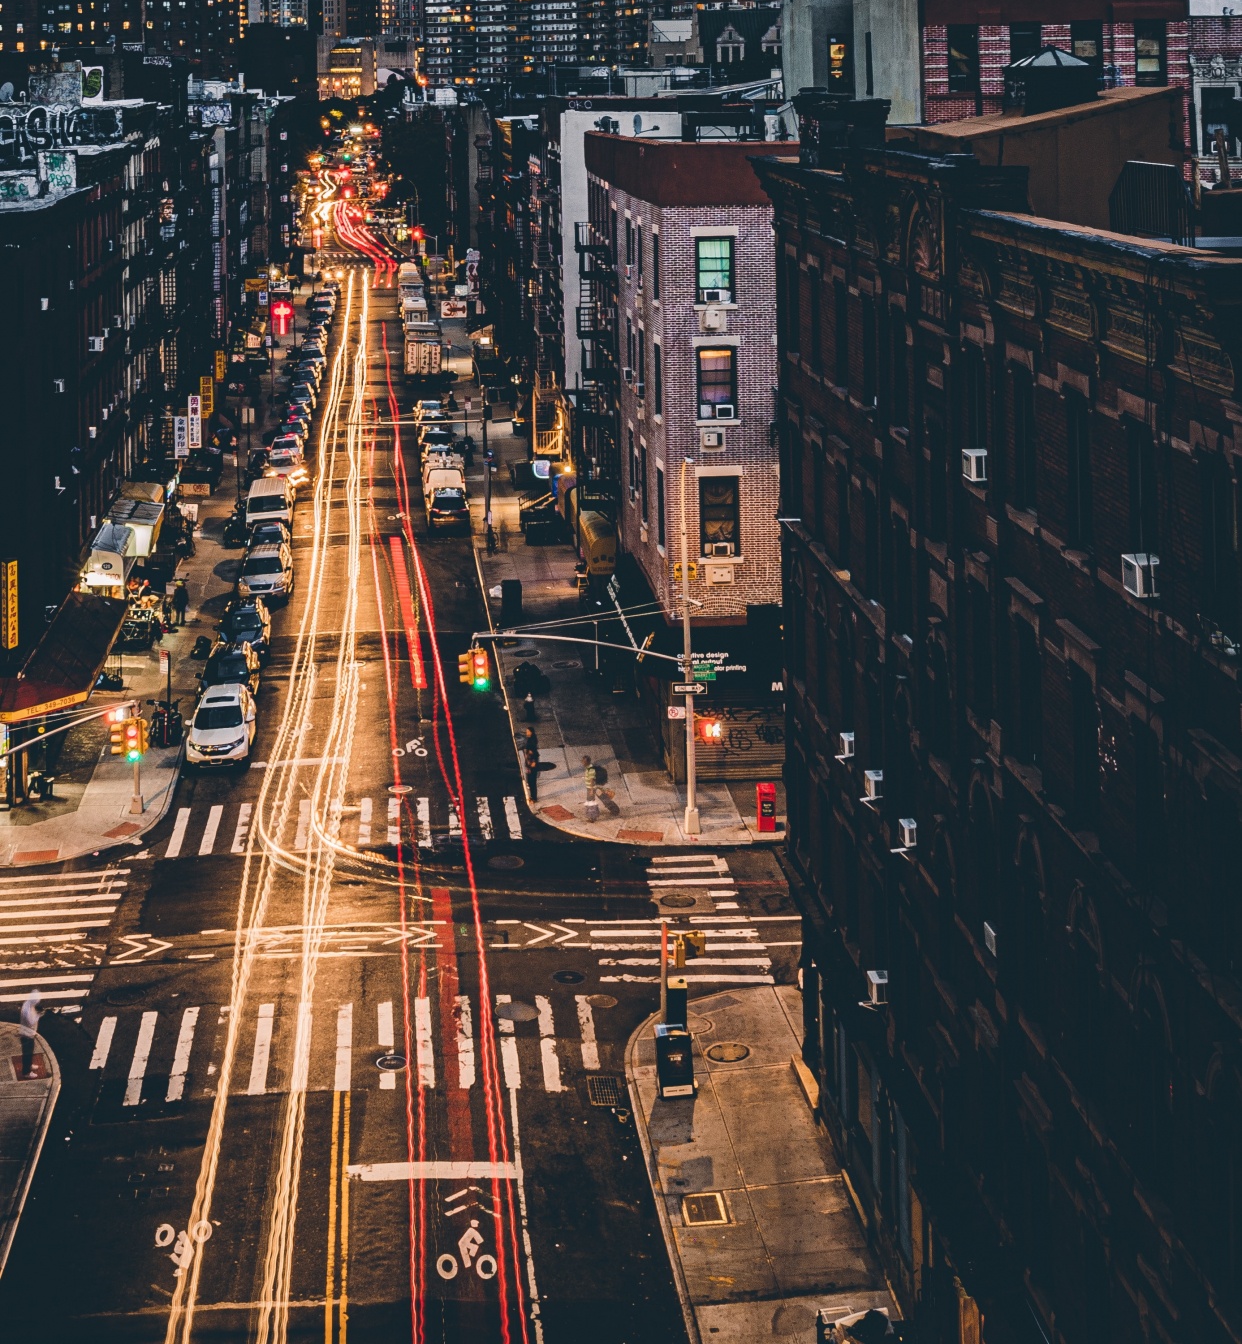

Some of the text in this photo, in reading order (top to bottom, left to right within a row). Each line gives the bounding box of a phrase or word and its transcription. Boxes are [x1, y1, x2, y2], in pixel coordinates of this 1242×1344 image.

[726, 664, 747, 672] printing
[772, 682, 783, 691] M
[44, 696, 76, 710] 349-7036
